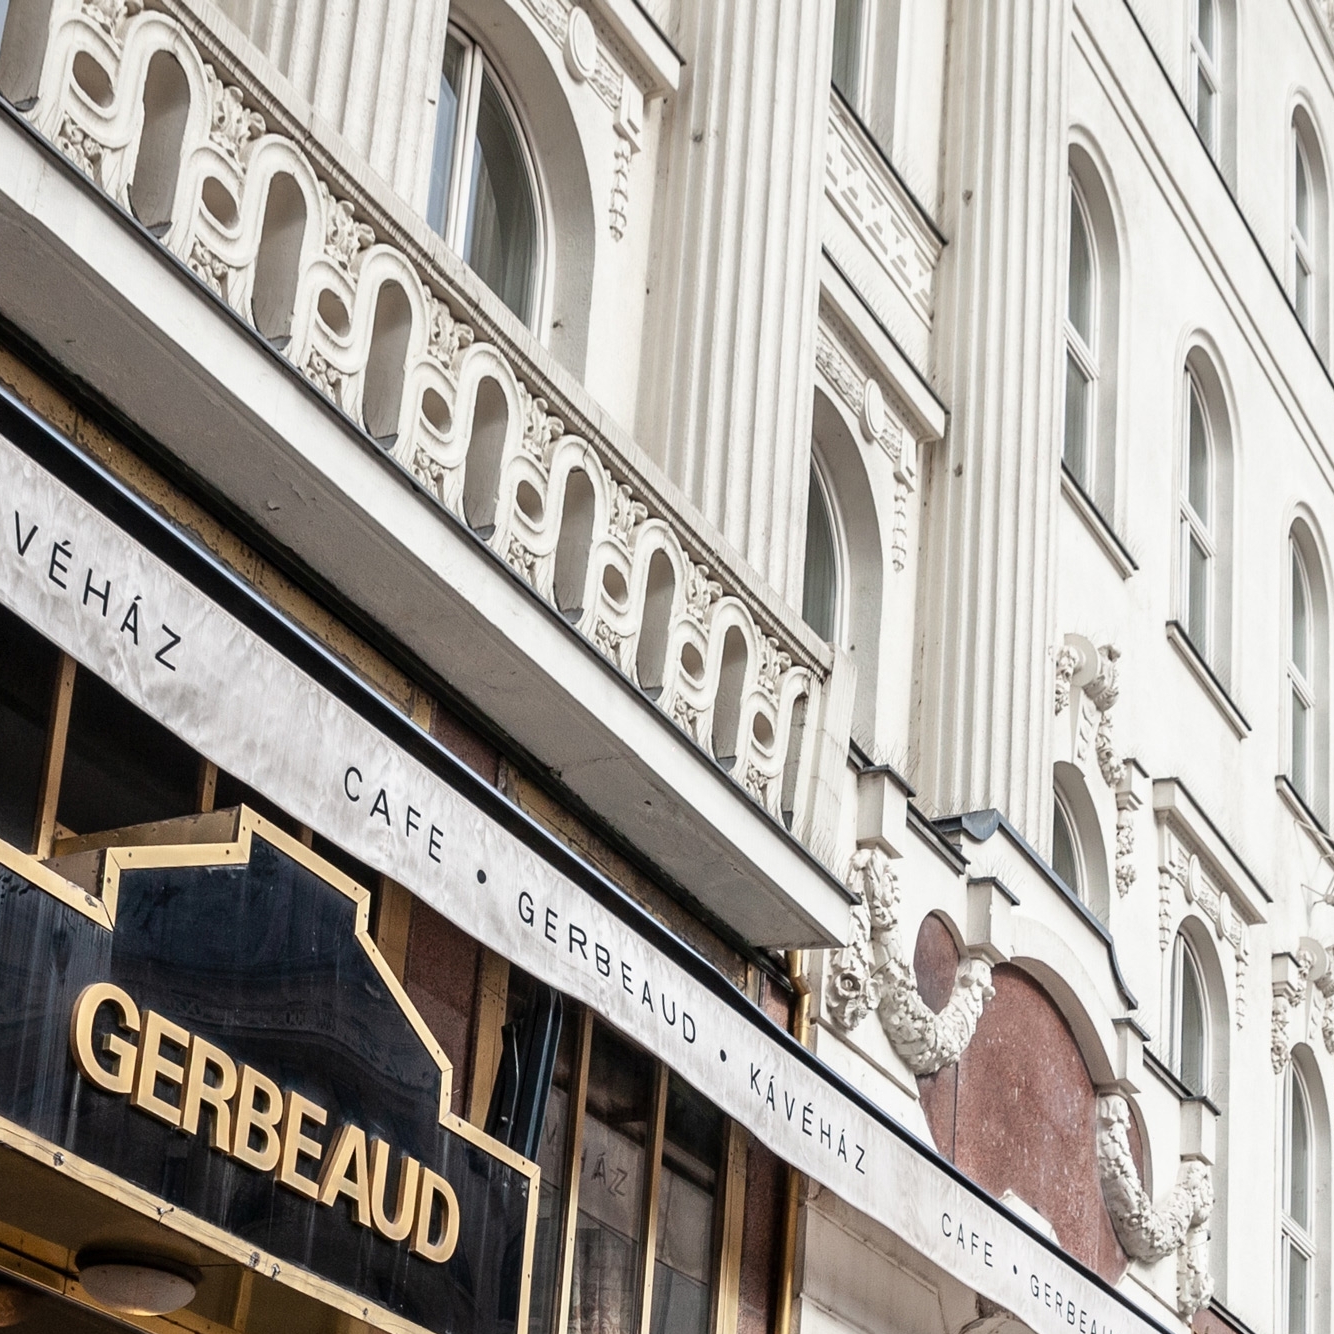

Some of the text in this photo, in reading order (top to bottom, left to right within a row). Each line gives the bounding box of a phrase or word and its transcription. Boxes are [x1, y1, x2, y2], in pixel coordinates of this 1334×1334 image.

[343, 766, 445, 866] CAFE
[518, 890, 697, 1045] GERBEAUD
[749, 1061, 866, 1176] KÁVÉHÁZ
[70, 982, 460, 1264] GERBEAUD
[941, 1211, 995, 1270] CAFE
